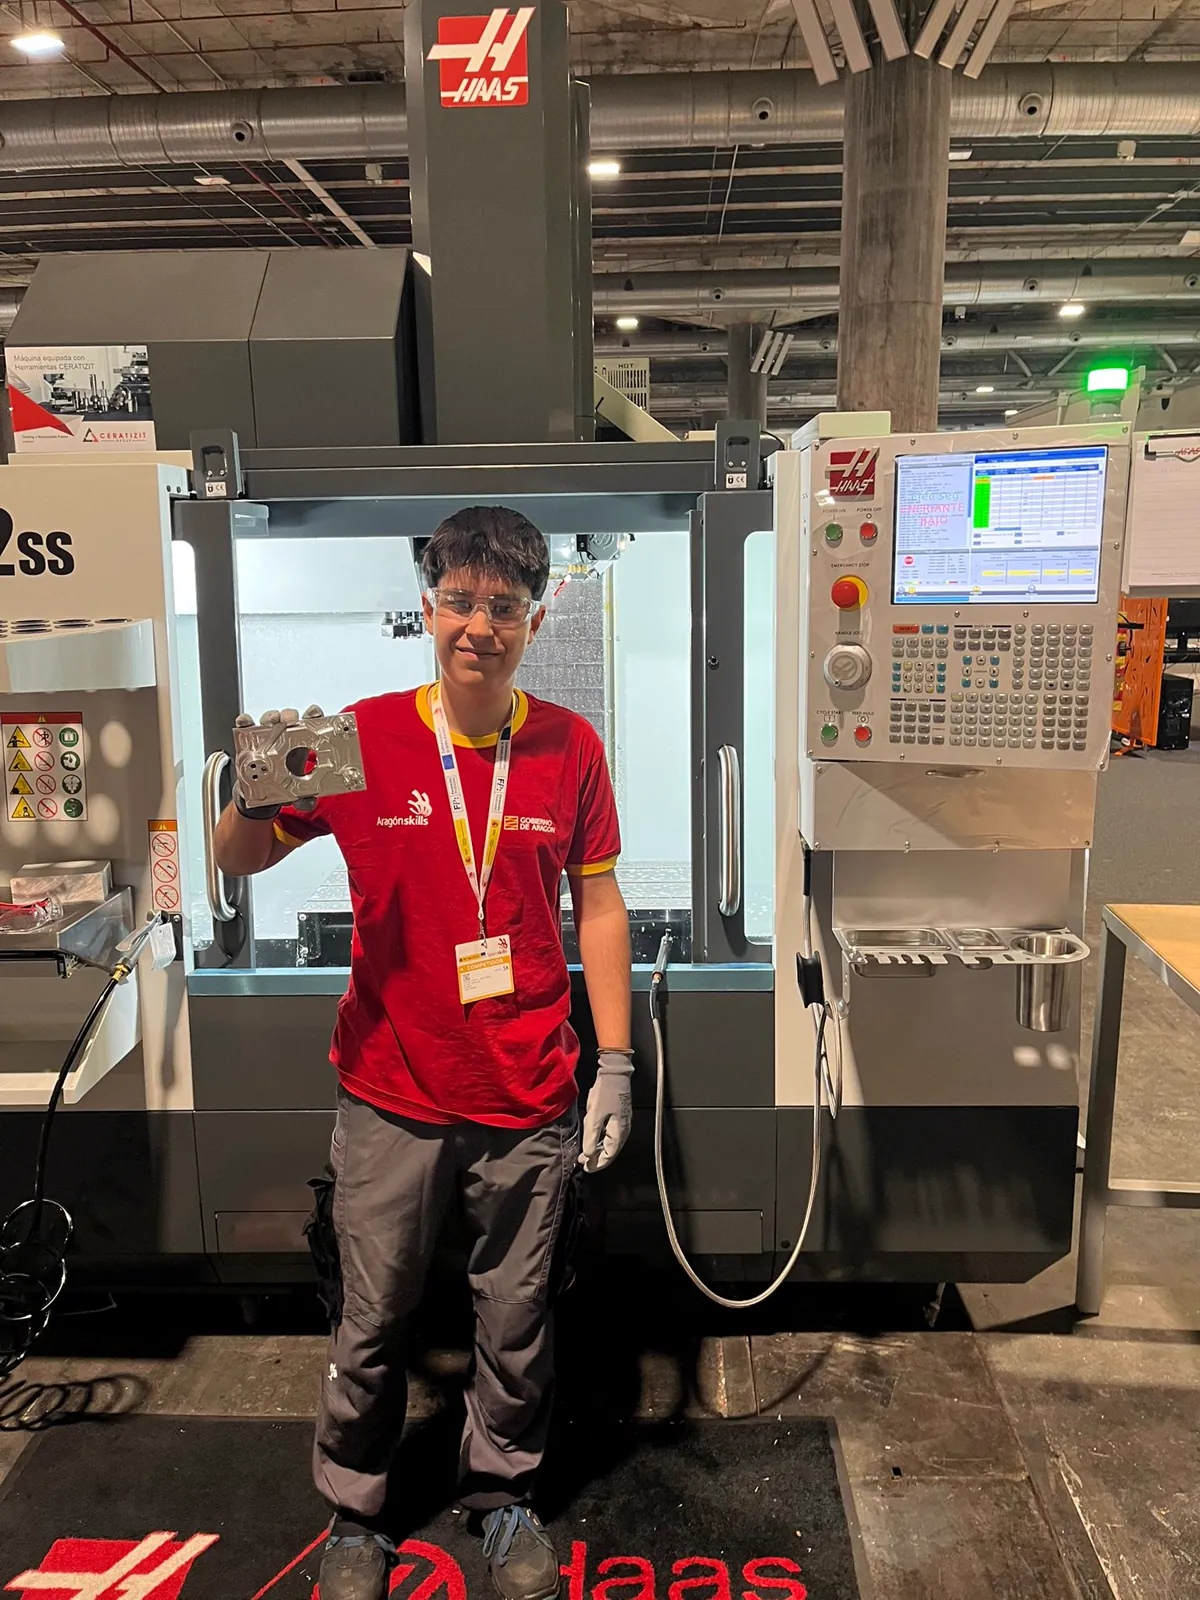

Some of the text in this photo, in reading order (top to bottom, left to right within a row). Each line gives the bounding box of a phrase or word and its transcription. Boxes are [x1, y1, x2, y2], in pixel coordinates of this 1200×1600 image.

[441, 76, 528, 103] HAAS
[14, 354, 41, 362] Máquina
[42, 354, 72, 362] equipada
[15, 363, 57, 371] Herramientas
[376, 815, 429, 828] Aragónskills
[520, 817, 553, 826] GOBIERNO
